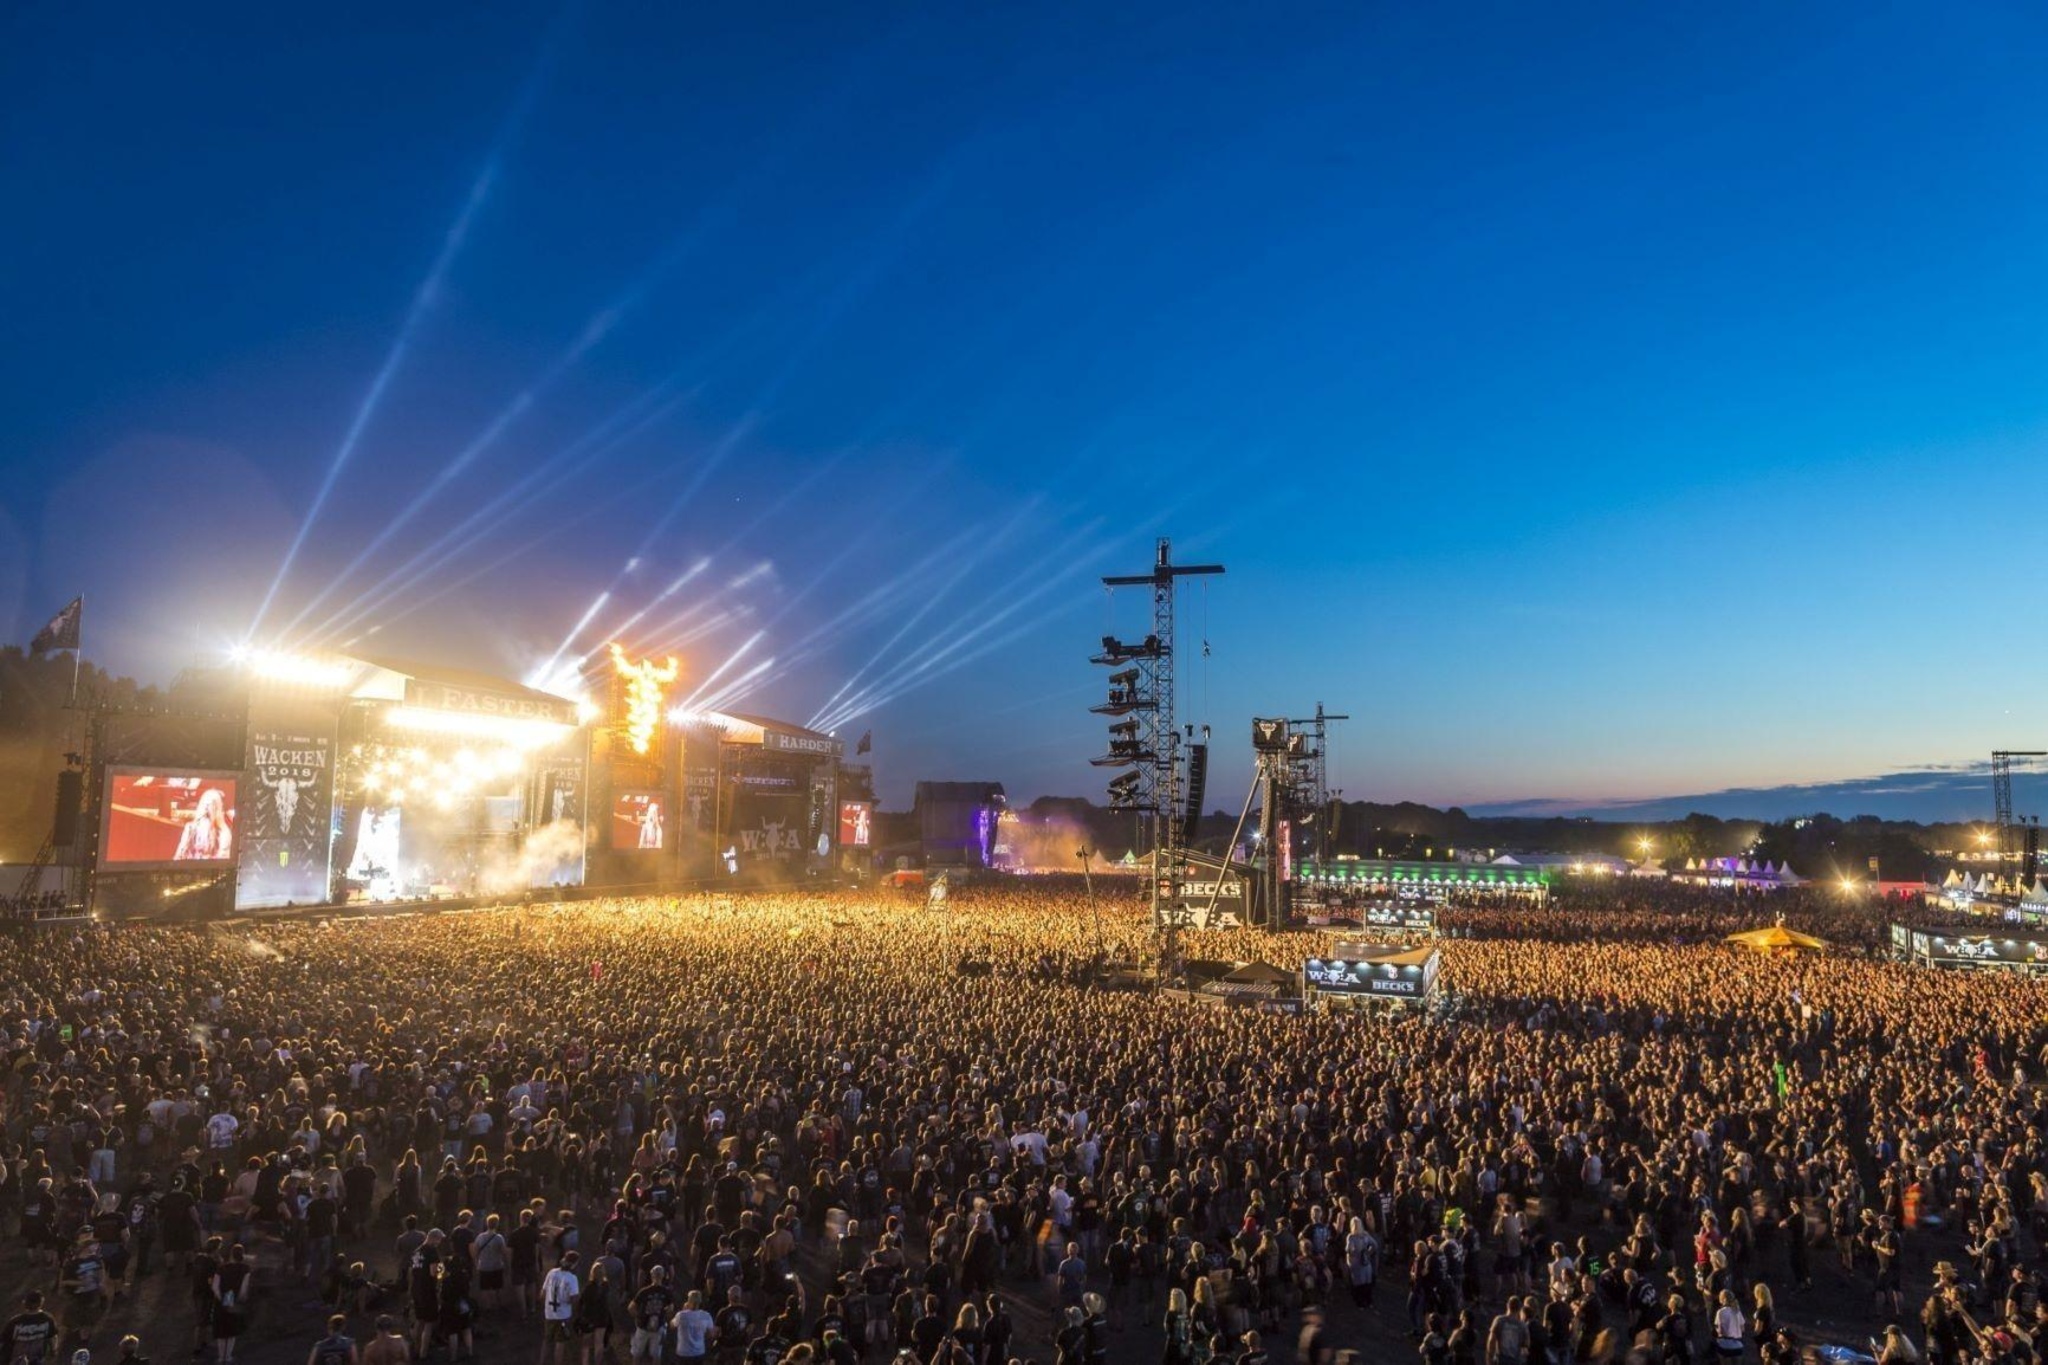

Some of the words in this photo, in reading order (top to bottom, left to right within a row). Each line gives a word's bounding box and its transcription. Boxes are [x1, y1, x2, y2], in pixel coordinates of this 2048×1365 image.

[441, 687, 553, 718] FASTER
[780, 734, 832, 753] HARDER
[254, 744, 327, 768] WACKEN
[268, 766, 312, 777] 2018
[1372, 980, 1415, 992] BECK'S
[1589, 1261, 1600, 1276] 15
